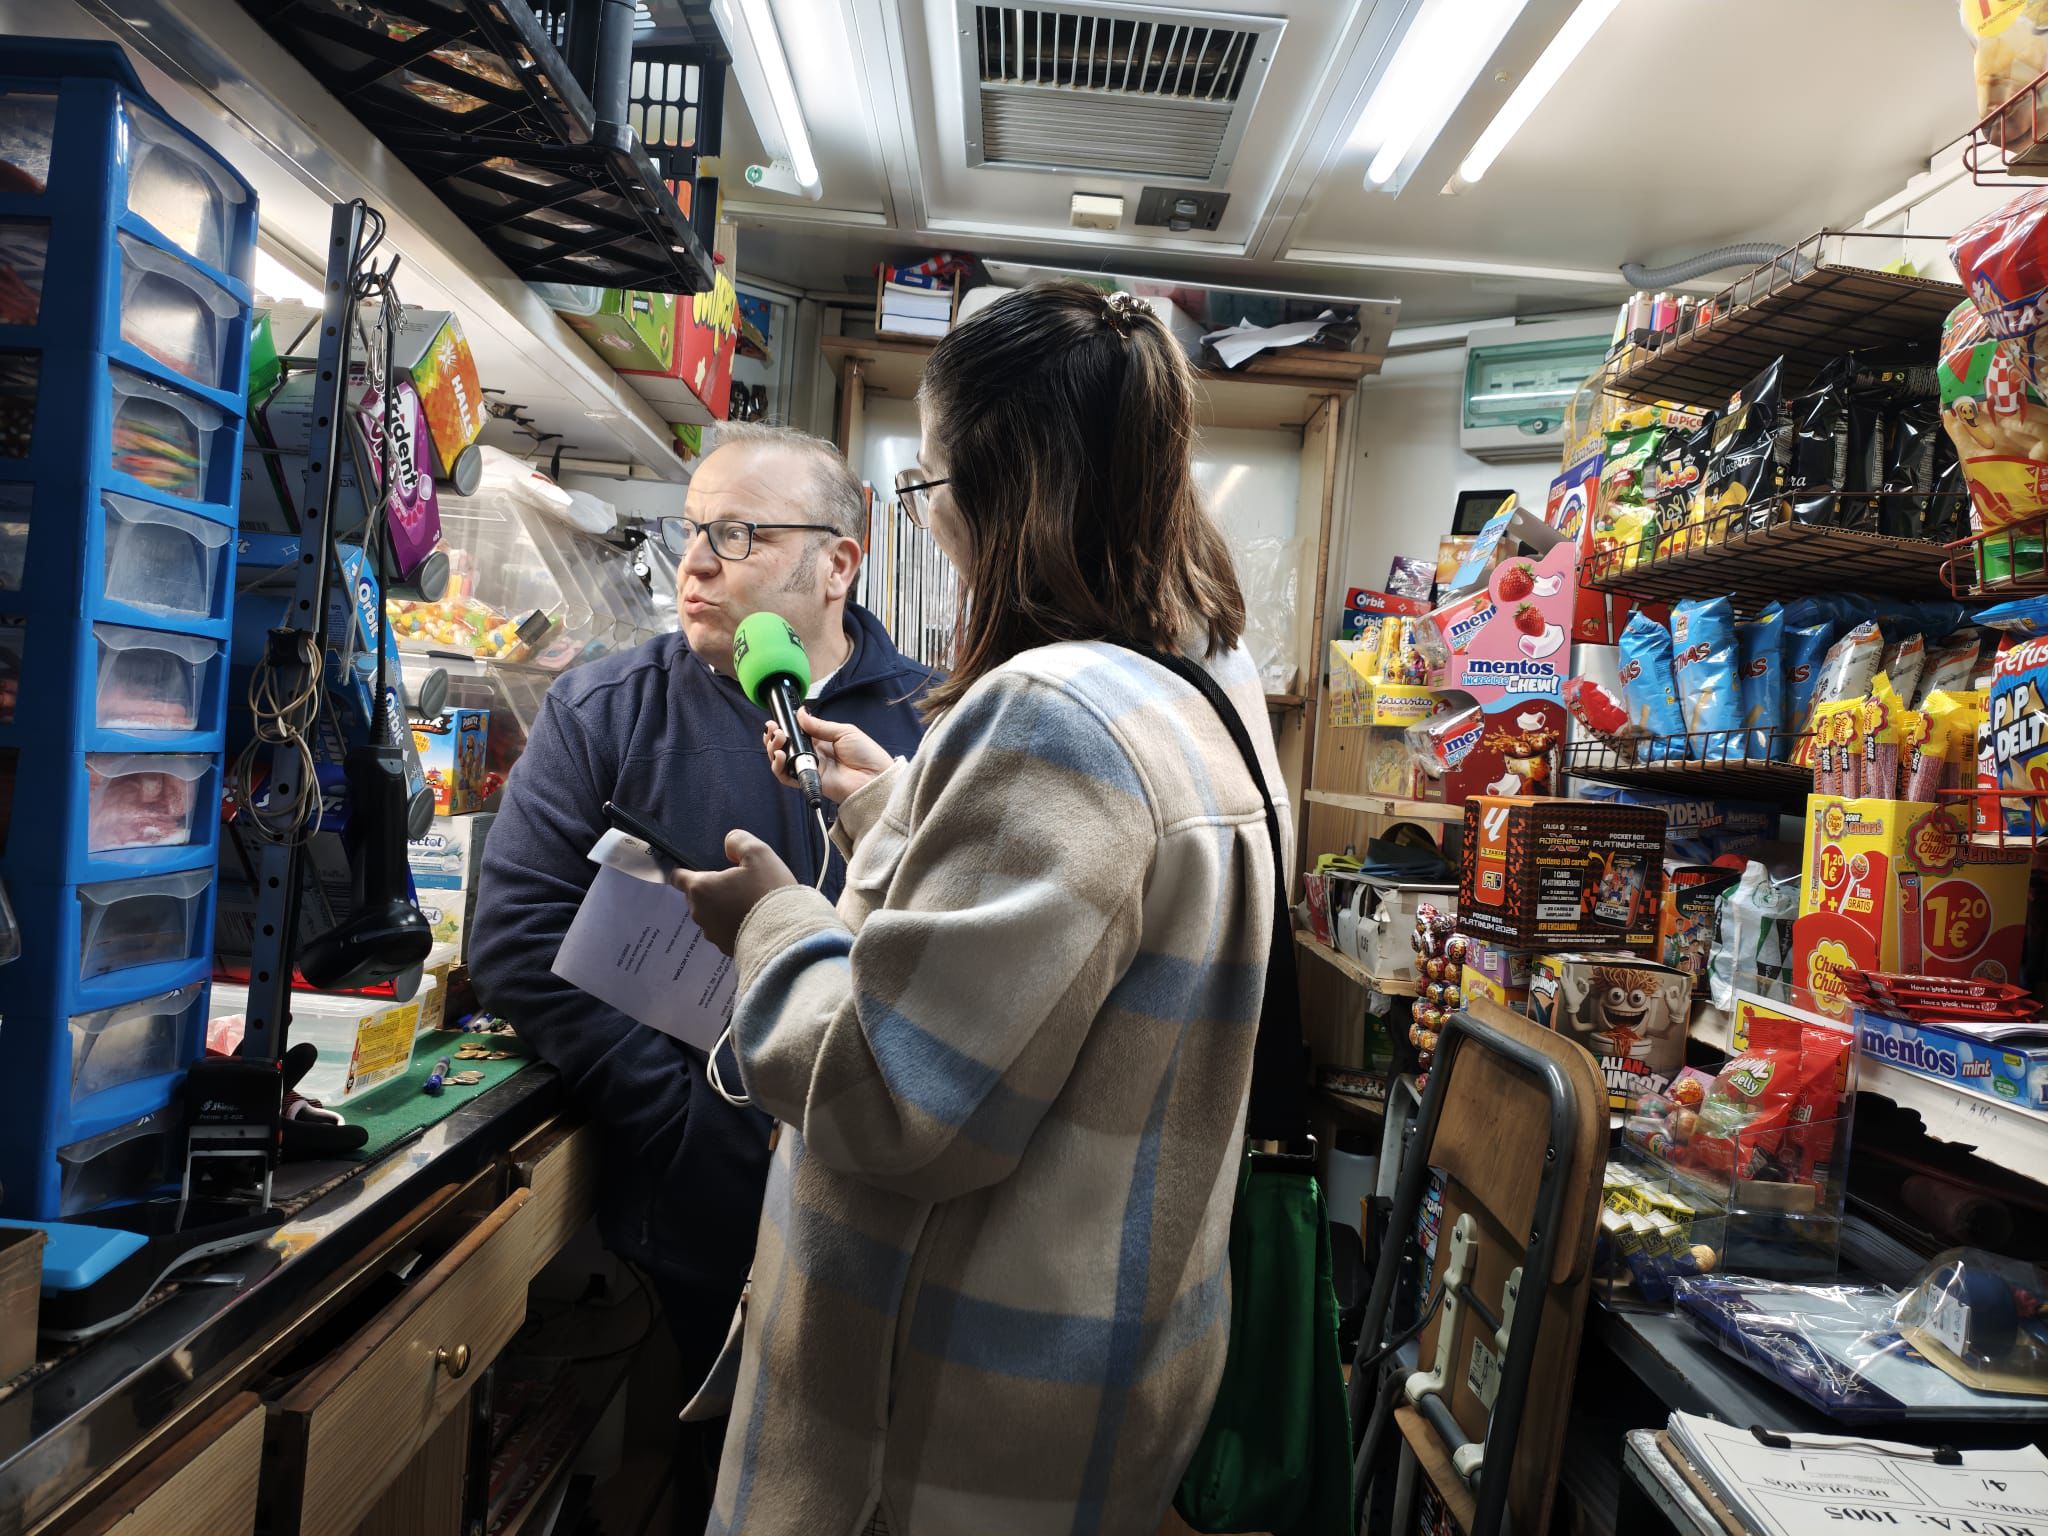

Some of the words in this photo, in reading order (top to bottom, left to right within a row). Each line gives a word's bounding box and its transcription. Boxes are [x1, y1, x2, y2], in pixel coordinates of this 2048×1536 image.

[450, 373, 476, 438] HALLS
[357, 577, 379, 638] Orbit
[1354, 591, 1386, 609] Orbit
[1469, 659, 1554, 676] mentos
[1506, 675, 1561, 696] CHEW!
[1867, 736, 1876, 760] SOUR
[1822, 748, 1831, 771] SOUR
[1841, 747, 1849, 770] SOUR
[1538, 837, 1589, 846] ADRENALYN
[1593, 840, 1635, 849] PLATINUM
[1636, 842, 1661, 850] 2026
[1847, 898, 1871, 911] GRATIS
[1472, 912, 1492, 921] POCKET
[1459, 917, 1495, 931] PLATINUM
[1495, 924, 1518, 936] 2026
[1862, 1028, 1958, 1077] mentos
[1962, 1061, 1992, 1078] mint
[1824, 1506, 1901, 1525] 1005
